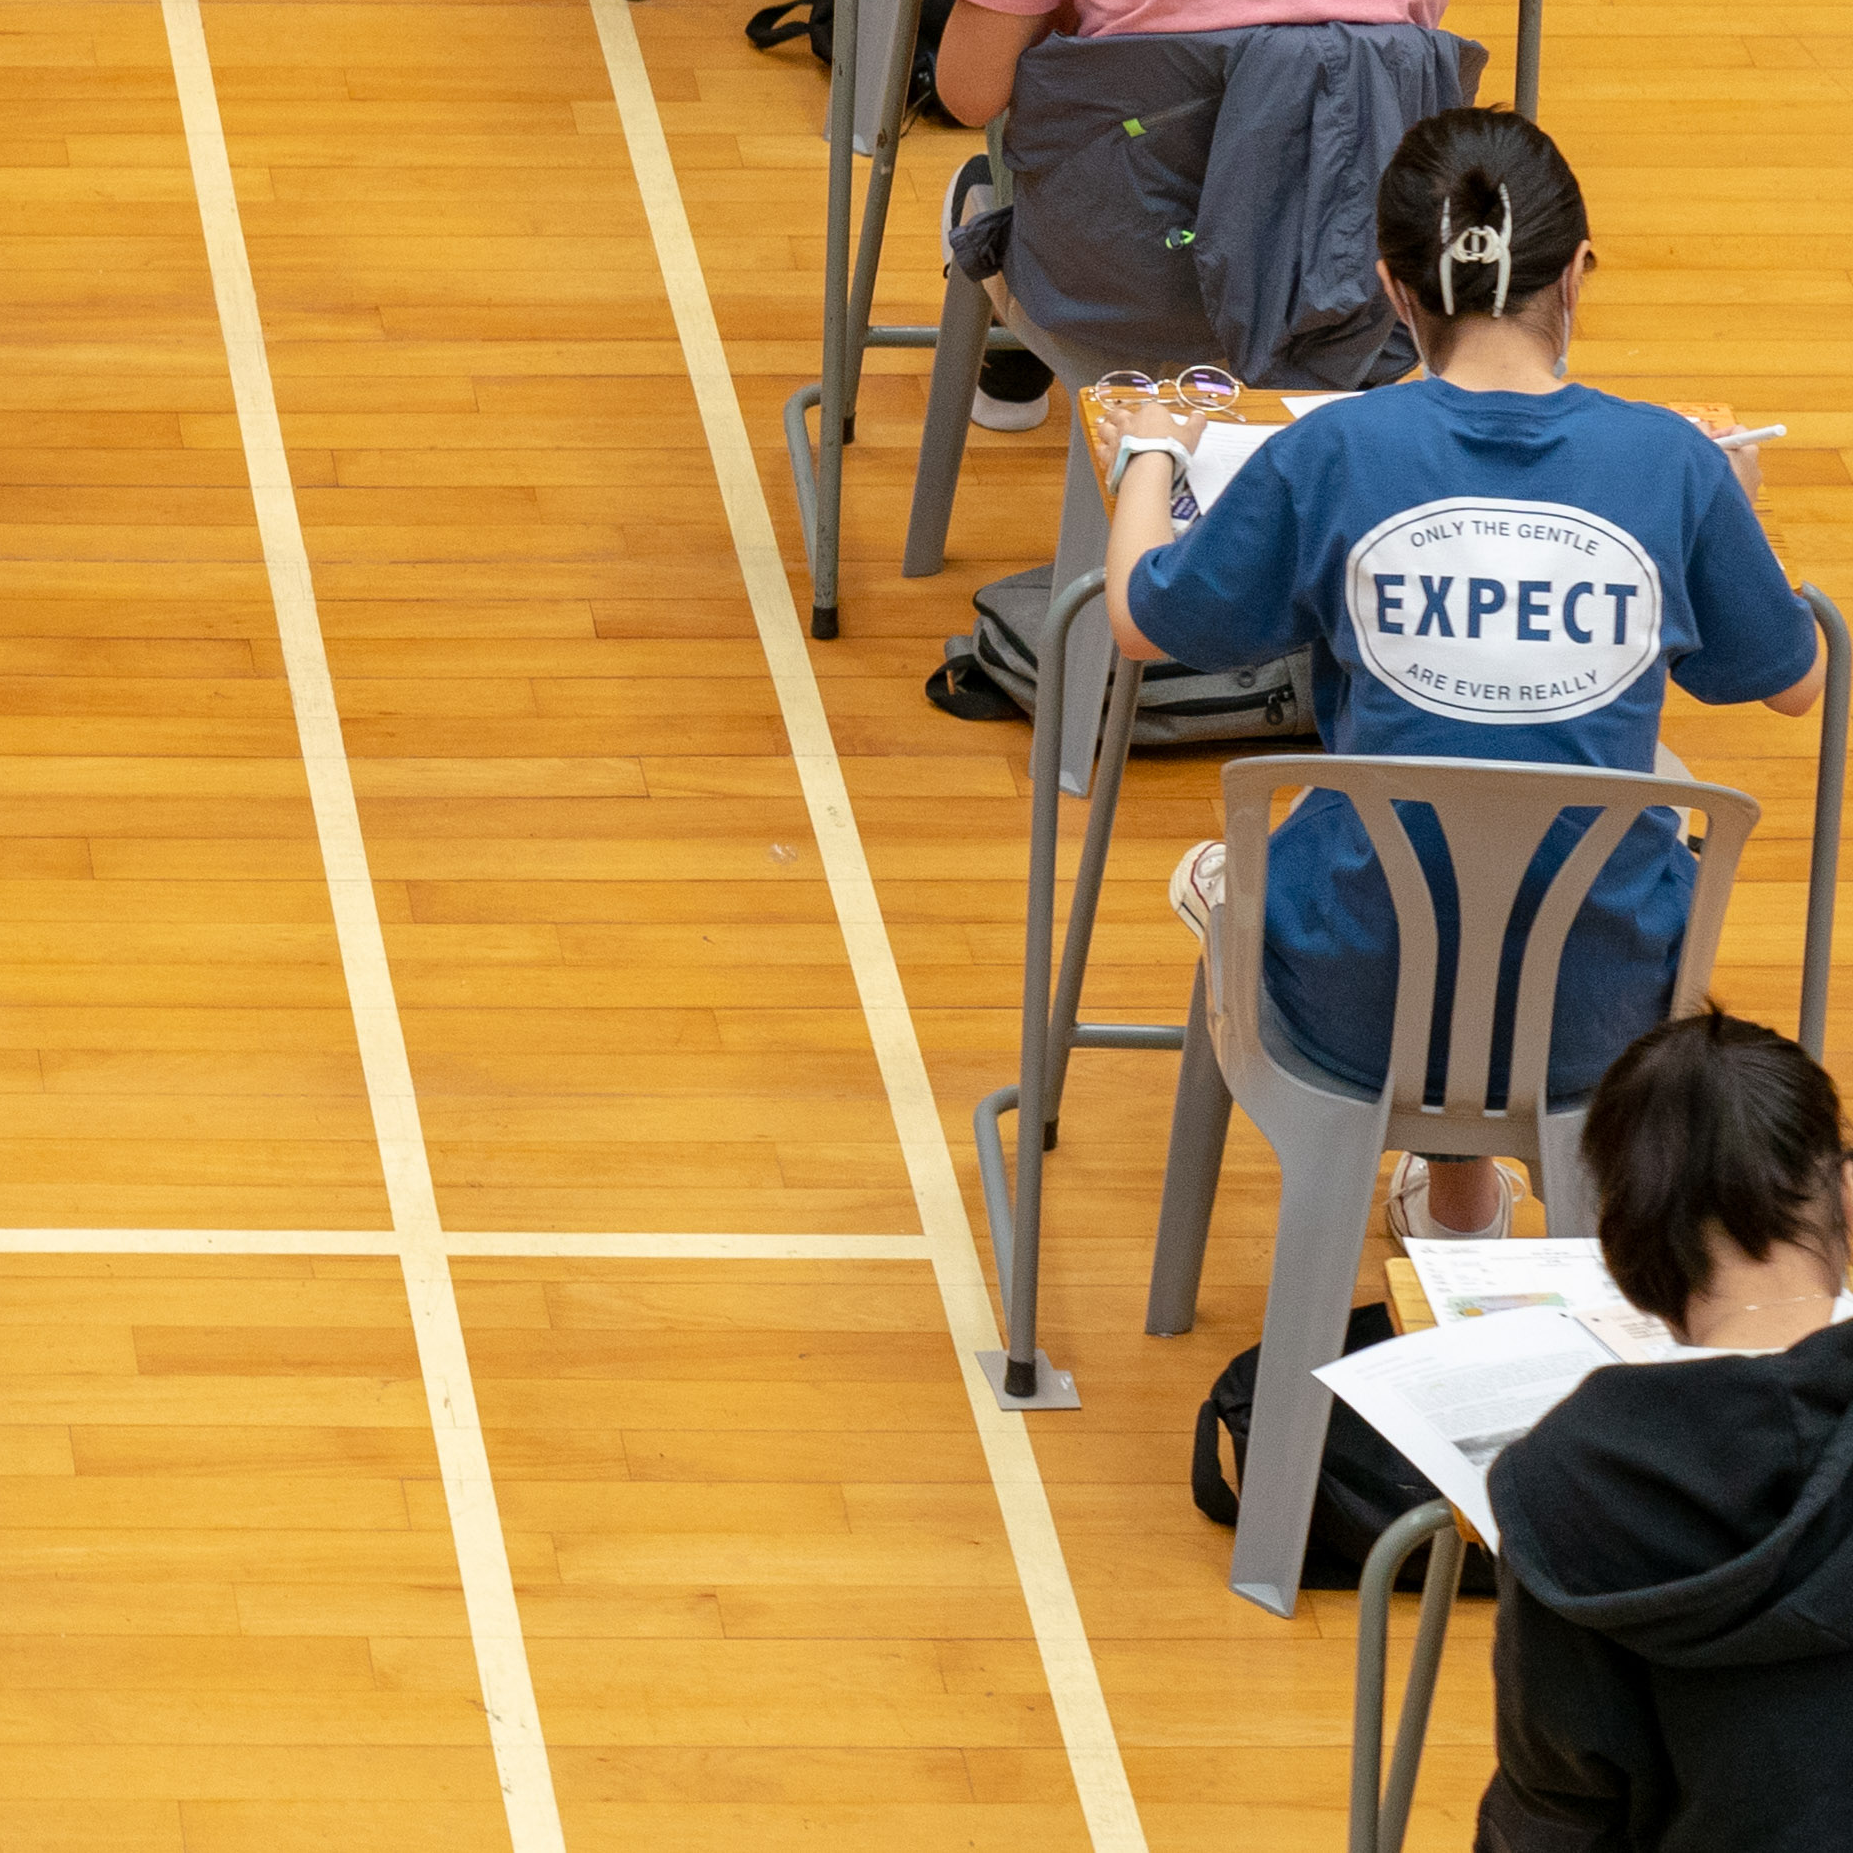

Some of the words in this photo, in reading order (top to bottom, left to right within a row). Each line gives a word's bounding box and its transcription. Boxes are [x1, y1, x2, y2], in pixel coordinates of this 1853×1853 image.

[1410, 520, 1465, 548] ONLY
[1471, 520, 1511, 537] THE
[1517, 523, 1600, 557] GENTLE
[1371, 573, 1639, 645] EXPECT
[1406, 663, 1446, 691] ARE
[1455, 678, 1511, 700] EVER
[1520, 669, 1599, 700] REALLY
